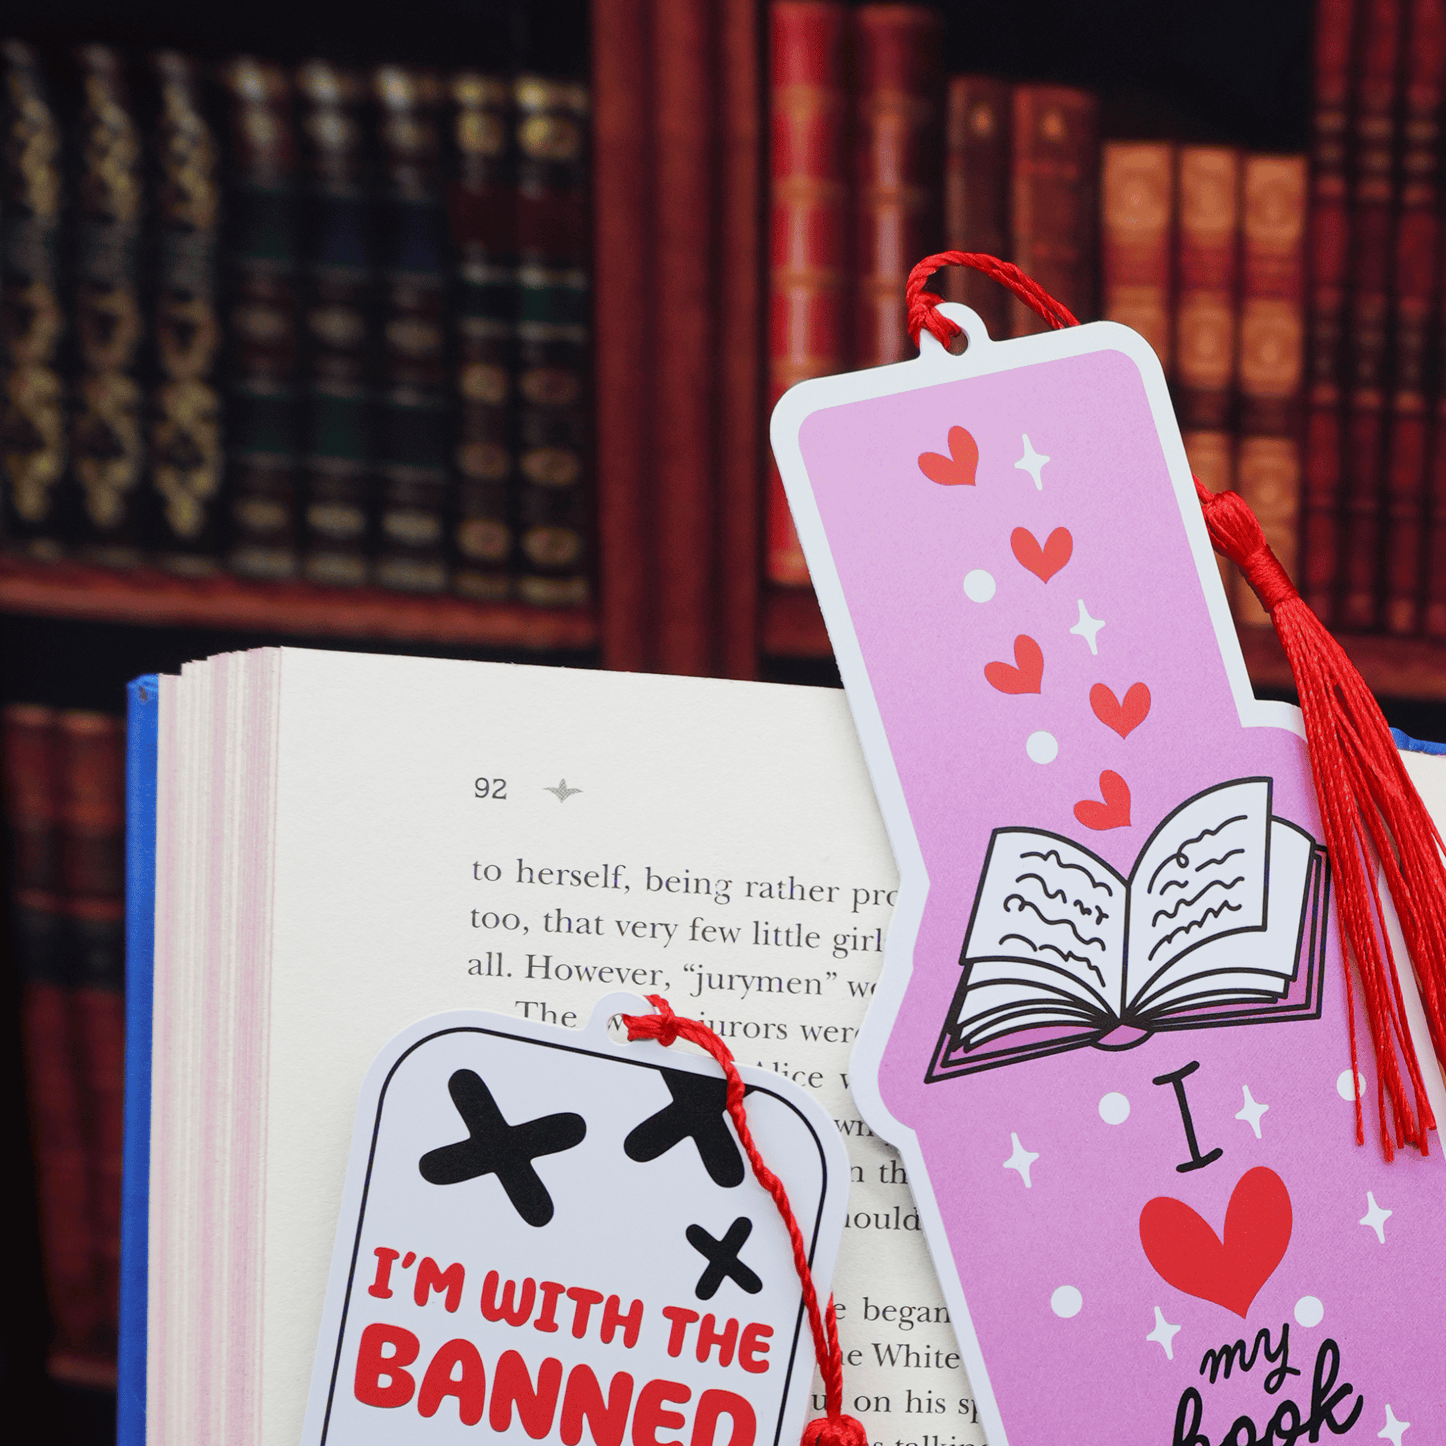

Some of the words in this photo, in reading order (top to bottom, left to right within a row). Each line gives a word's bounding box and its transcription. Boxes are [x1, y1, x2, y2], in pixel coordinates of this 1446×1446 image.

[474, 776, 507, 801] 92
[472, 860, 502, 882] to
[515, 857, 630, 895] herself,
[644, 866, 733, 906] being
[745, 875, 840, 903] rather
[470, 908, 529, 936] too,
[543, 907, 605, 936] that
[614, 919, 679, 949] very
[688, 916, 742, 944] few
[752, 920, 821, 949] little
[467, 951, 513, 978] all.
[524, 953, 671, 992] However,
[683, 963, 838, 1000] “jurymen”
[1152, 1061, 1223, 1173] I
[368, 1246, 465, 1313] I'M
[481, 1269, 644, 1349] WITH
[662, 1306, 774, 1374] THE
[869, 1341, 960, 1371] White
[1201, 1323, 1300, 1392] my
[853, 1395, 892, 1413] on
[904, 1388, 947, 1415] his
